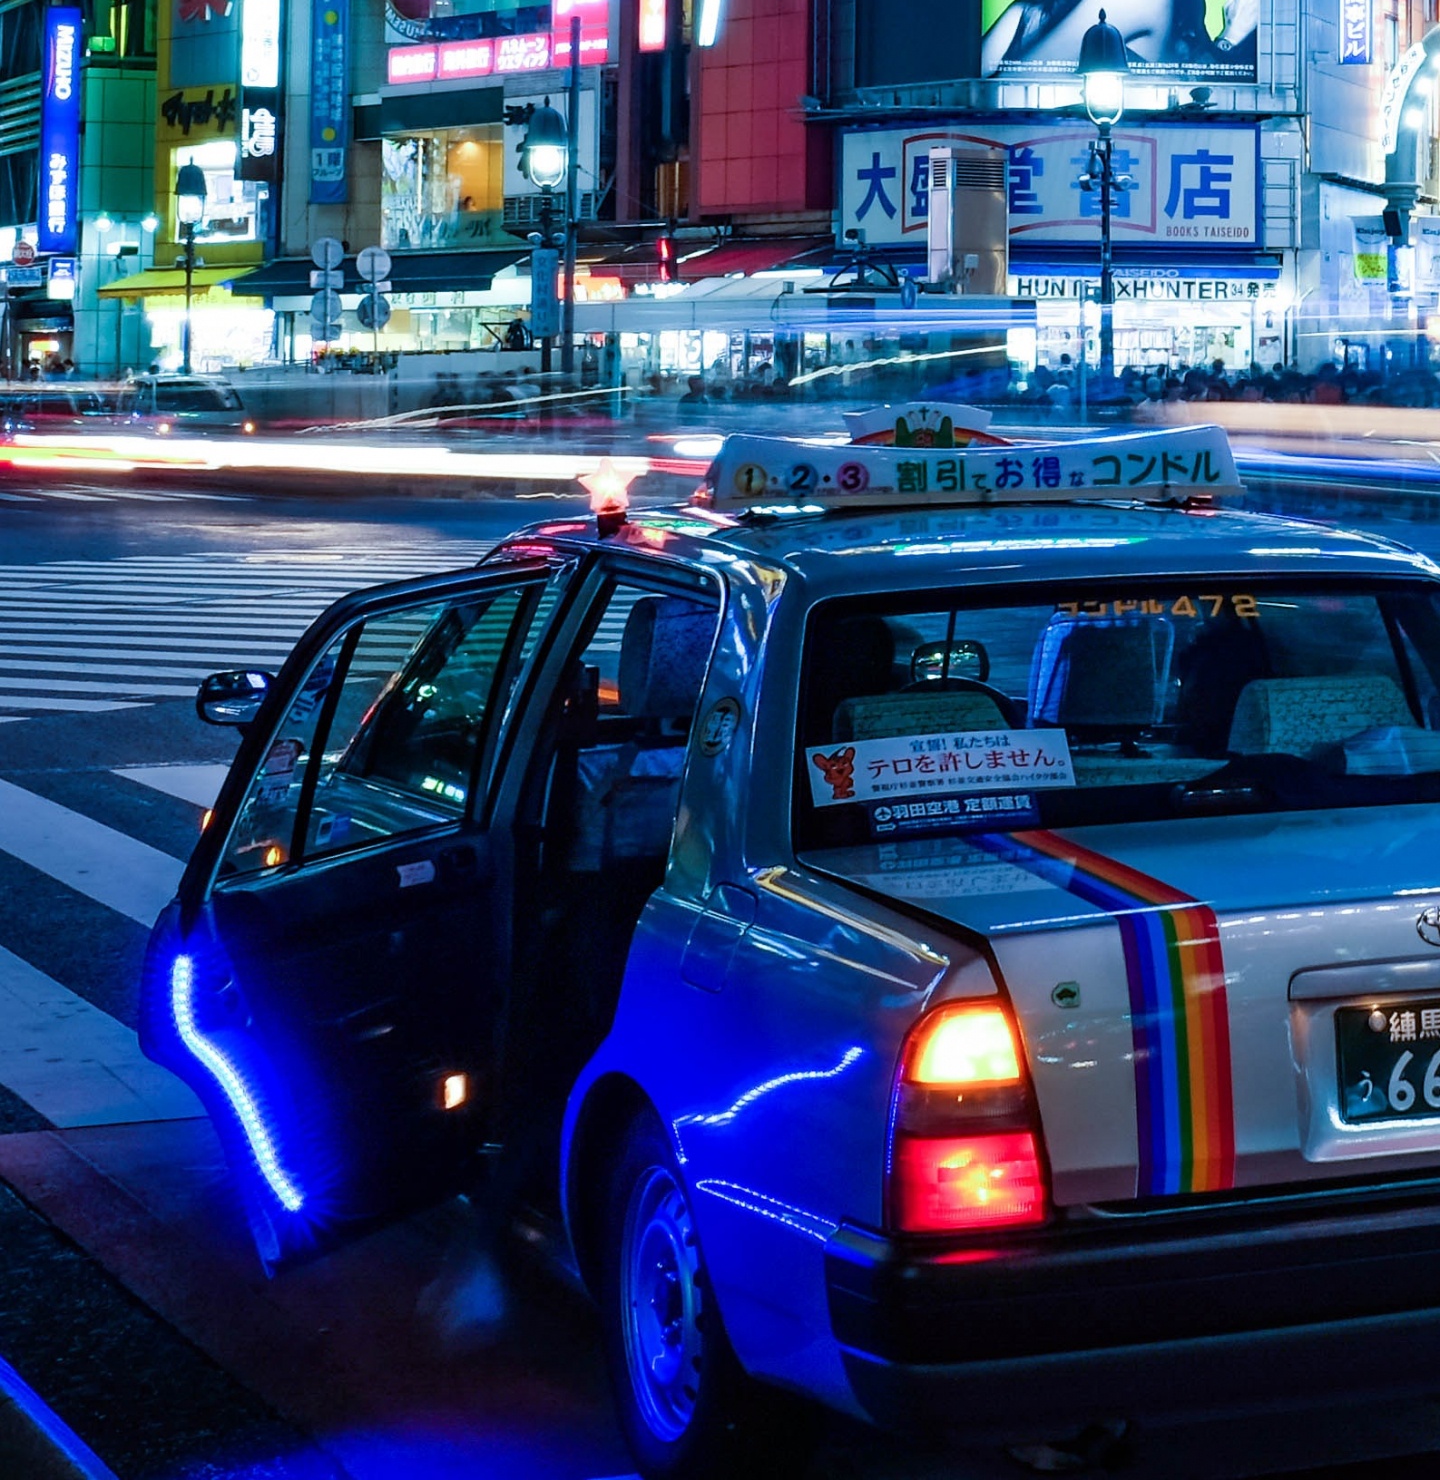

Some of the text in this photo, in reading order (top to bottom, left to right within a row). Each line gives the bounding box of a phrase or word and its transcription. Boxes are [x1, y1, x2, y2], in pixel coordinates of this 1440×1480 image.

[1166, 226, 1250, 238] BOOKS TAISEIDO
[1109, 268, 1180, 279] AISEIDO
[1170, 594, 1262, 618] 472
[867, 748, 1066, 780] テロを許しません。
[891, 799, 961, 820] 羽田空港
[1360, 1070, 1374, 1102] う
